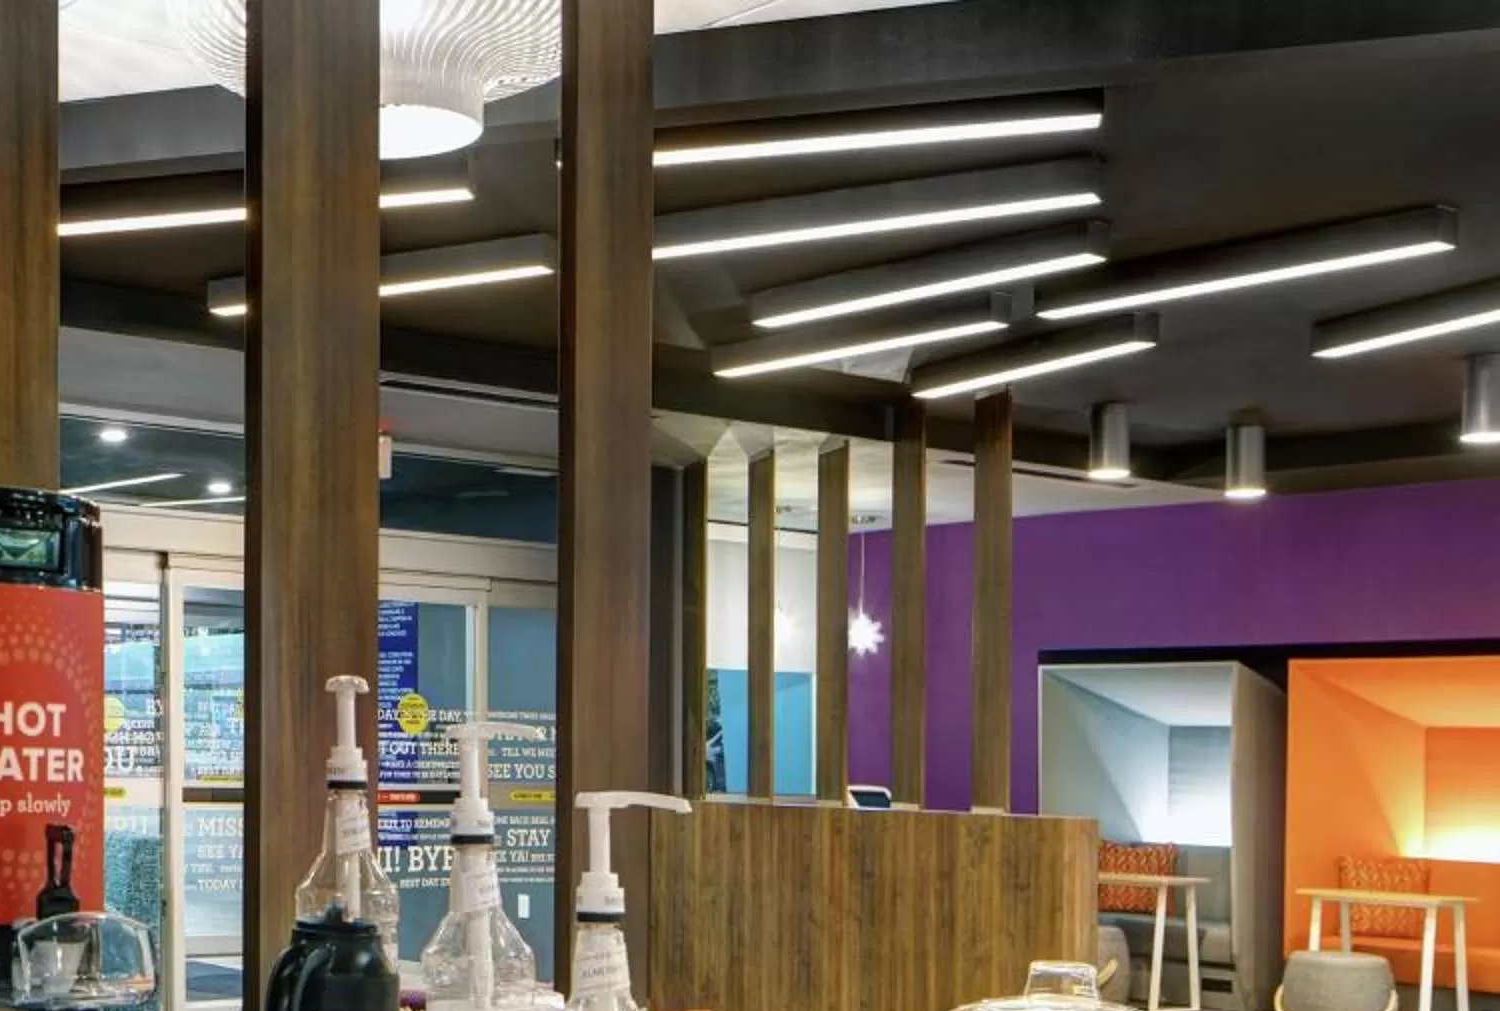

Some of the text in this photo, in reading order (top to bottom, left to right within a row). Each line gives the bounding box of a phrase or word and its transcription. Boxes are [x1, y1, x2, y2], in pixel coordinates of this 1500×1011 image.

[513, 763, 546, 779] YOU
[17, 792, 71, 817] slowly
[507, 827, 551, 848] STAY
